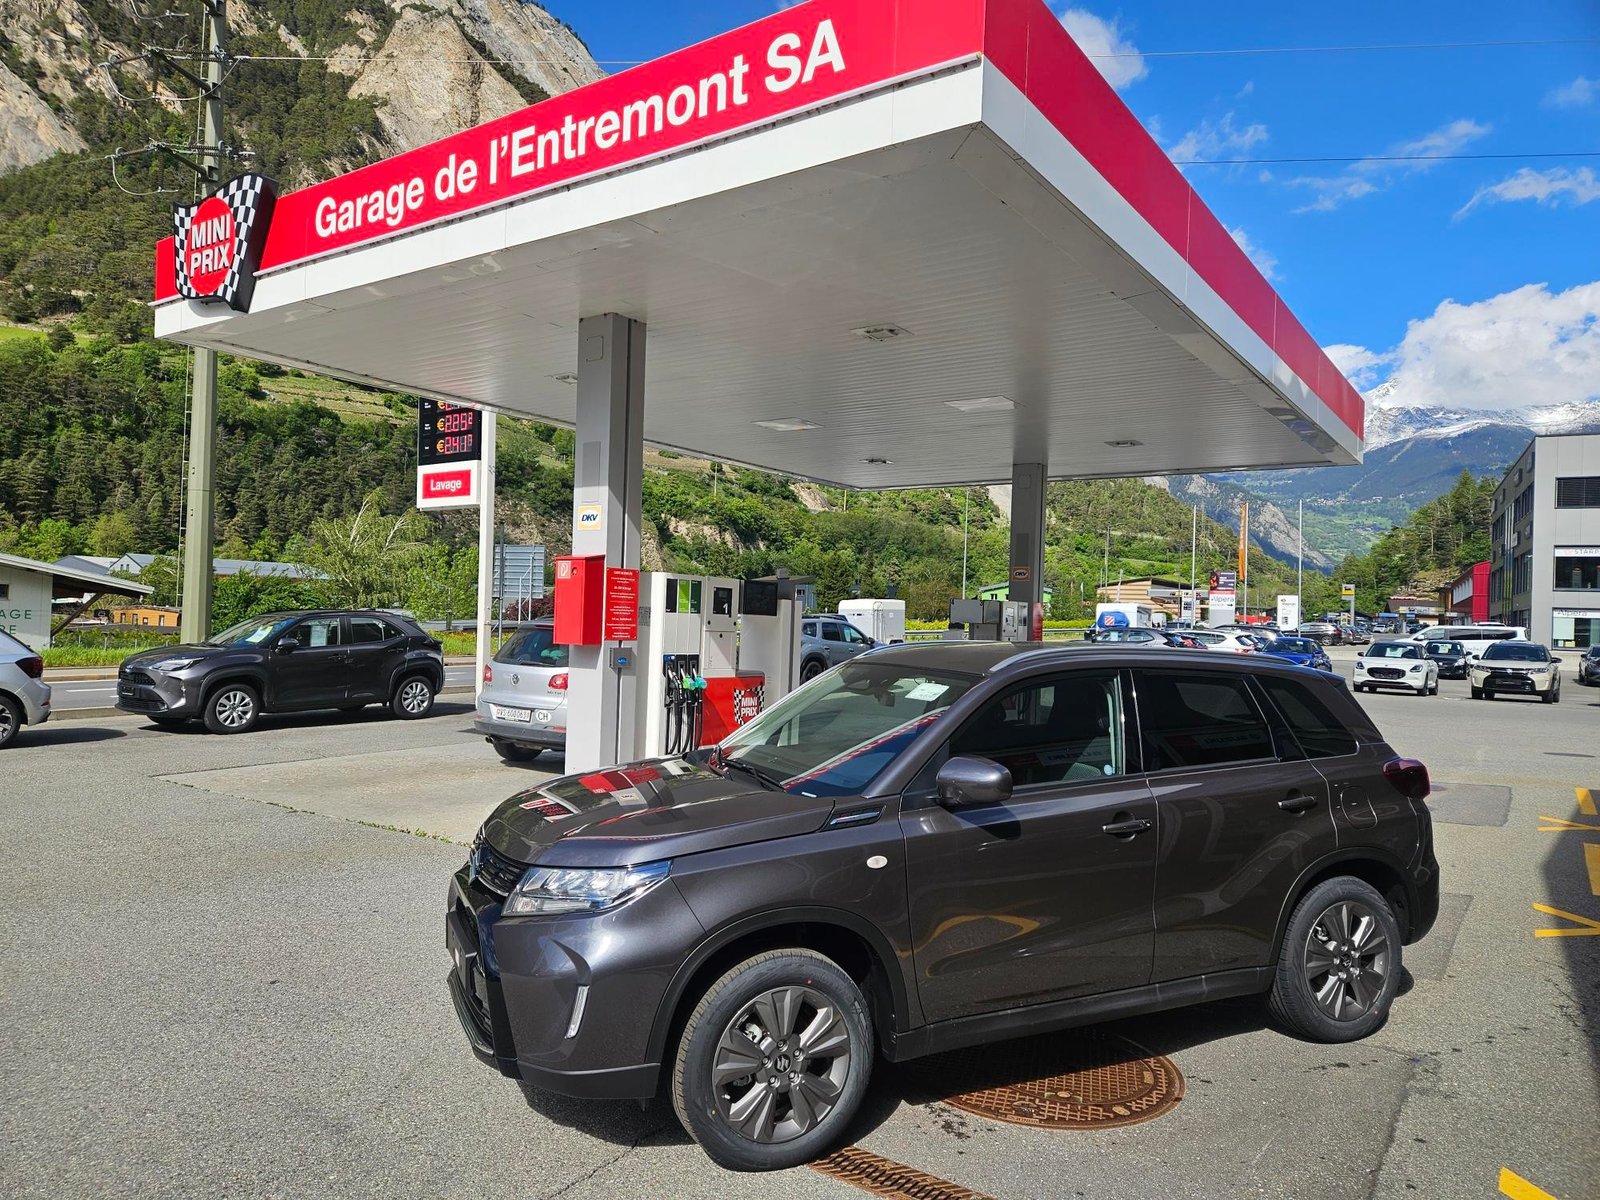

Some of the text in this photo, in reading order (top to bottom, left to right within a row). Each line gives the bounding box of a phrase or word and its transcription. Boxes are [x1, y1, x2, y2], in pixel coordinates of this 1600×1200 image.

[315, 18, 846, 238] Garage de l'Entremont SA
[190, 212, 231, 250] MINI
[189, 244, 230, 279] PRIX
[430, 479, 462, 492] Lavage
[581, 513, 598, 521] DKV
[723, 603, 729, 614] 1
[741, 697, 758, 707] MINI
[537, 711, 549, 721] CH
[740, 706, 758, 718] PRIX
